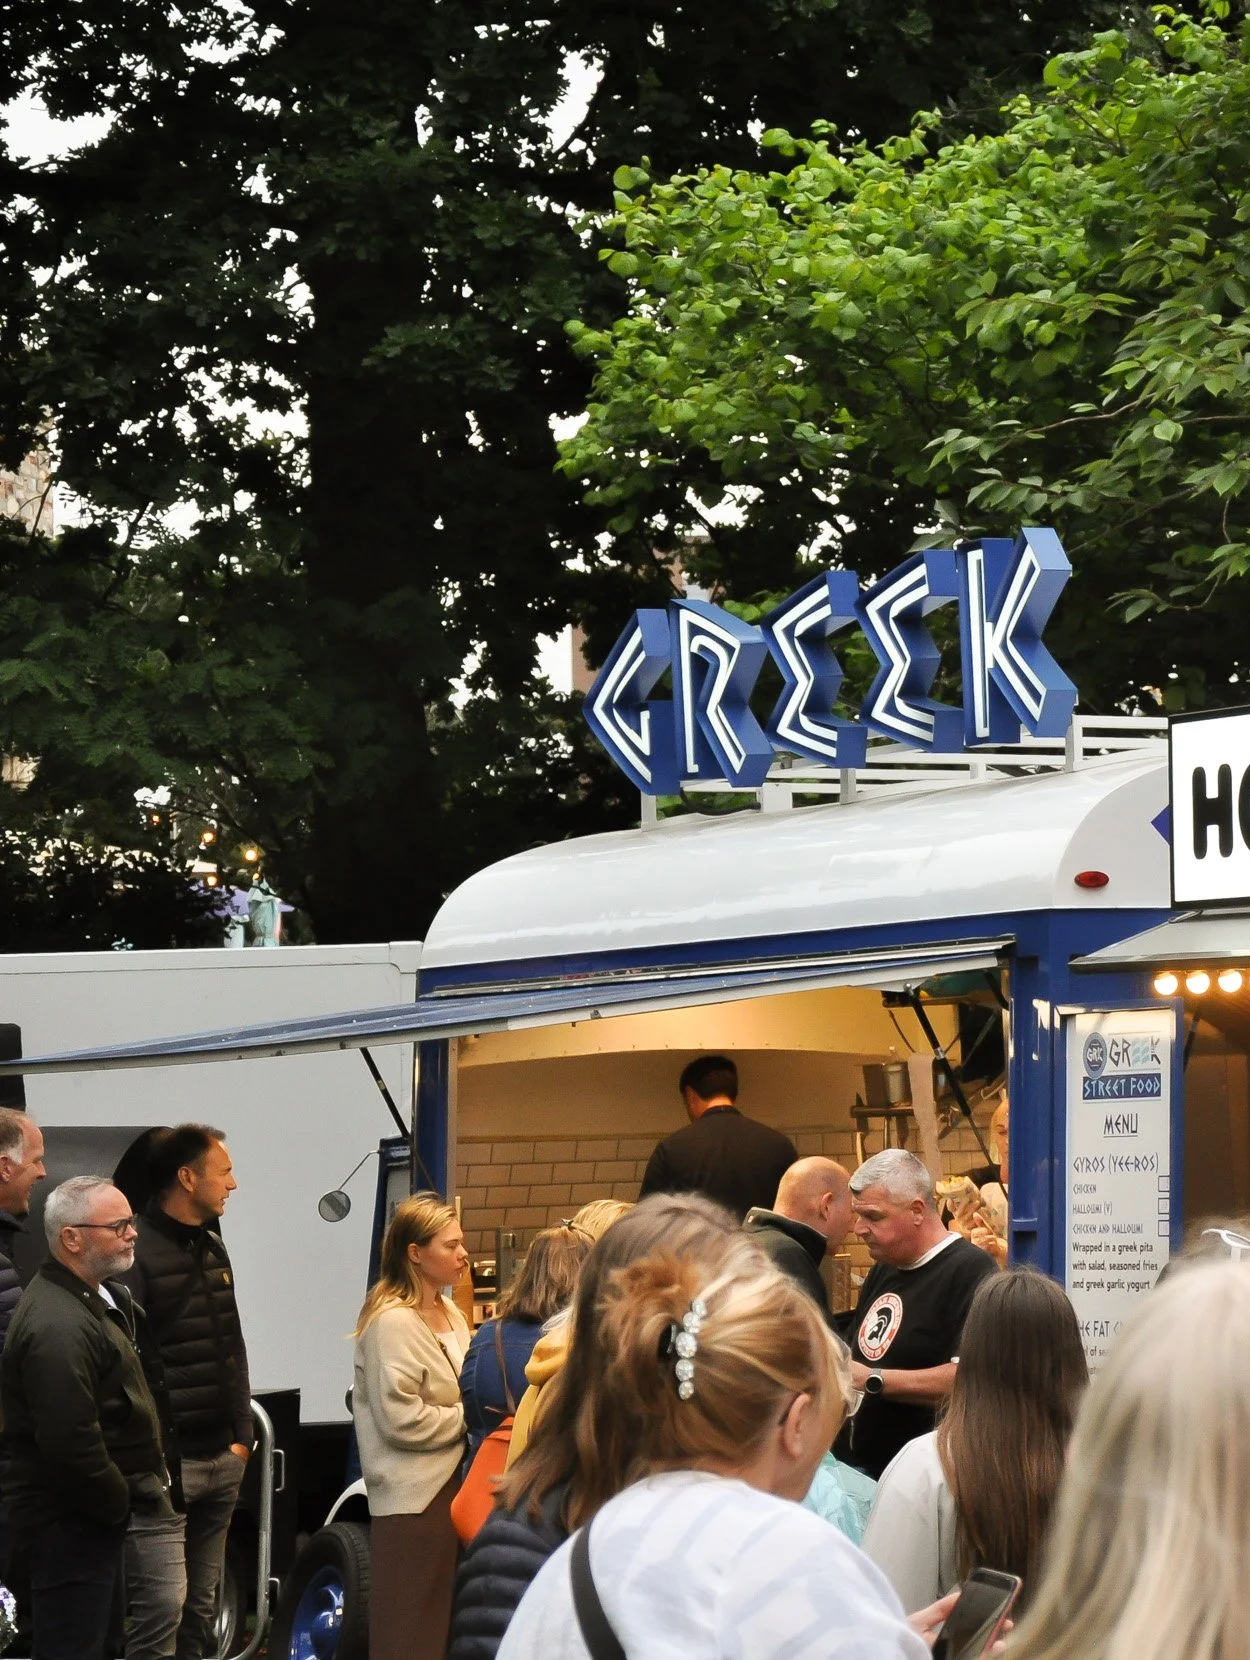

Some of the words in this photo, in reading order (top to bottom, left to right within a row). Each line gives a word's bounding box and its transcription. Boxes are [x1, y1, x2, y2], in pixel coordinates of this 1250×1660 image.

[582, 527, 1078, 796] GREEK
[1083, 1078, 1125, 1097] STREET
[1130, 1076, 1160, 1096] FOOD
[1103, 1112, 1138, 1135] MENU
[1073, 1156, 1105, 1173] GYROS
[1108, 1152, 1159, 1175] (YEE-ROS)
[1072, 1184, 1097, 1195] CHICKEN
[1072, 1204, 1102, 1214] HALLOUMI
[1072, 1223, 1097, 1234] CHICKEN
[1098, 1223, 1110, 1234] AND
[1112, 1223, 1143, 1234] HALLOUMI
[1072, 1242, 1103, 1255] Wrapped
[1104, 1242, 1110, 1252] in
[1118, 1241, 1138, 1255] greek
[1140, 1242, 1153, 1255] pita
[1072, 1259, 1087, 1270] with
[1088, 1260, 1106, 1271] salad,
[1109, 1260, 1141, 1271] seasoned
[1143, 1260, 1158, 1270] fries
[1072, 1278, 1084, 1289] and
[1086, 1278, 1105, 1291] greek
[1107, 1278, 1125, 1291] garlic
[1127, 1280, 1151, 1292] yogurt
[1093, 1320, 1110, 1337] FAT
